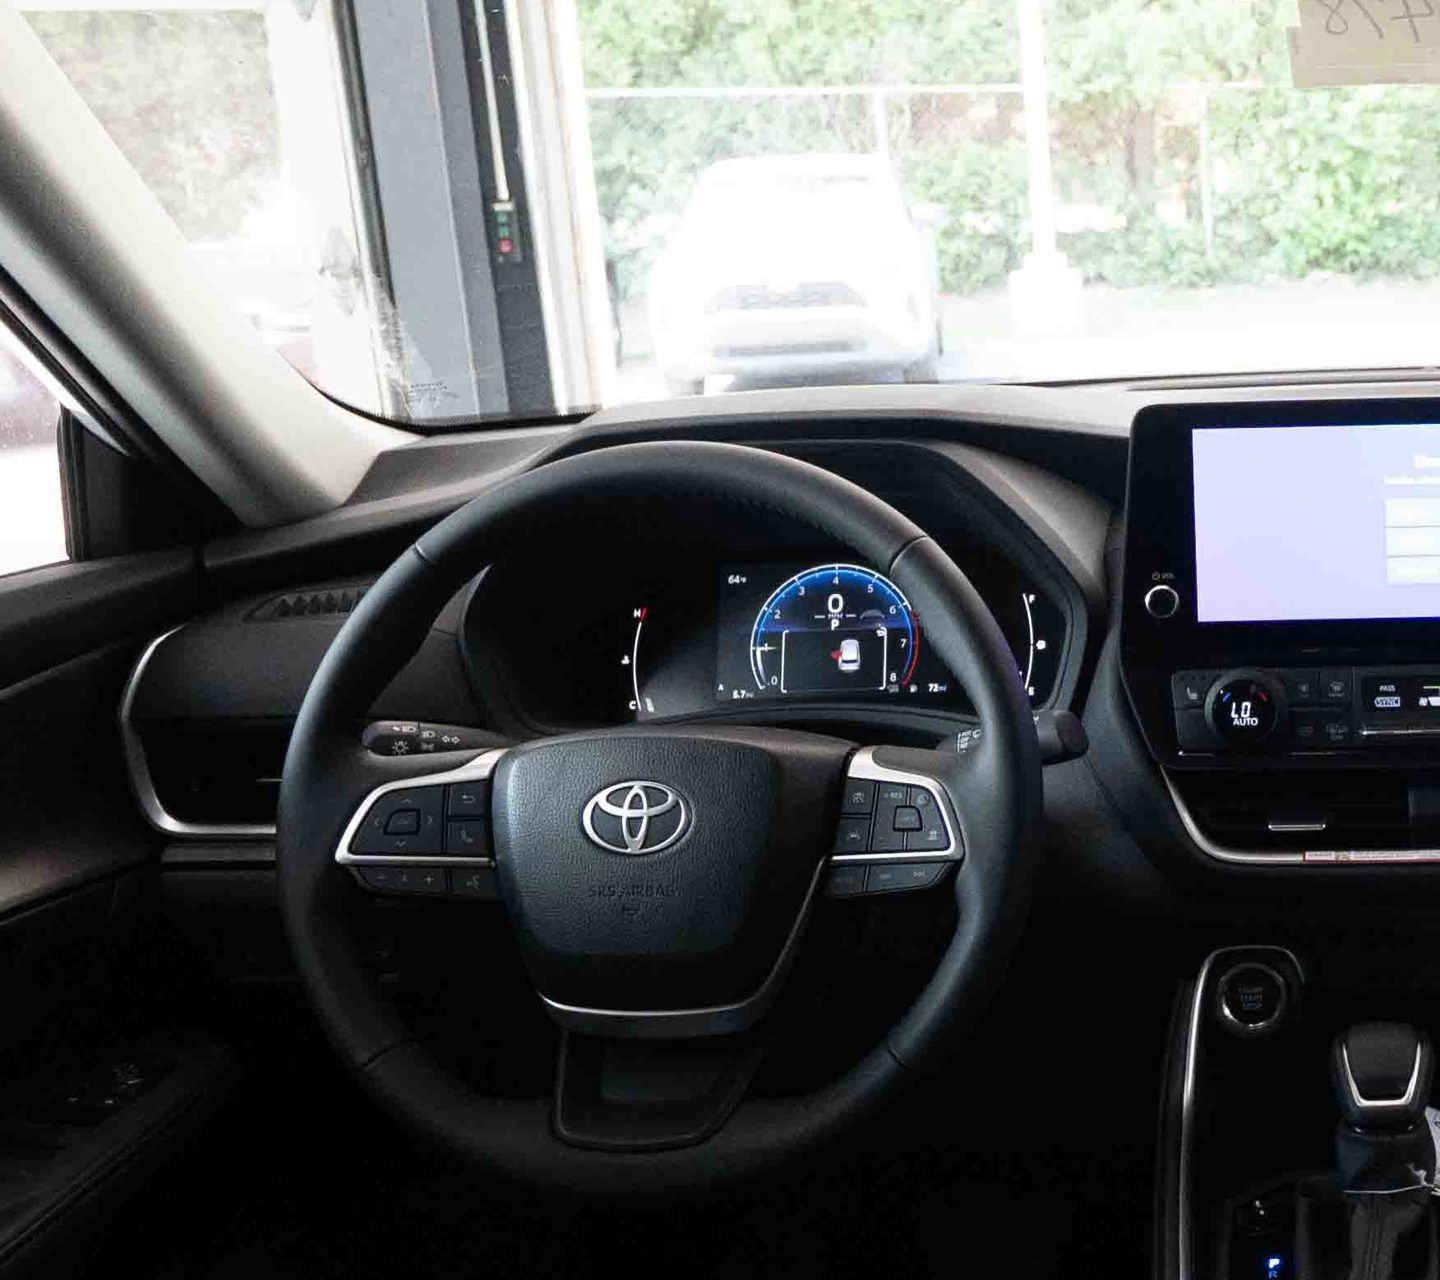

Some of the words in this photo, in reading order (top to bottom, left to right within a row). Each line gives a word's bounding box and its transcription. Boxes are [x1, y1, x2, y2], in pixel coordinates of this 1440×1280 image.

[832, 577, 841, 587] 4
[798, 585, 808, 598] 3
[866, 584, 875, 594] 5
[826, 593, 845, 613] 0
[773, 610, 783, 621] 2
[888, 604, 898, 616] 6
[831, 619, 840, 631] P
[1232, 716, 1259, 727] AUTO
[1268, 1257, 1280, 1270] P
[1268, 1270, 1279, 1279] R
